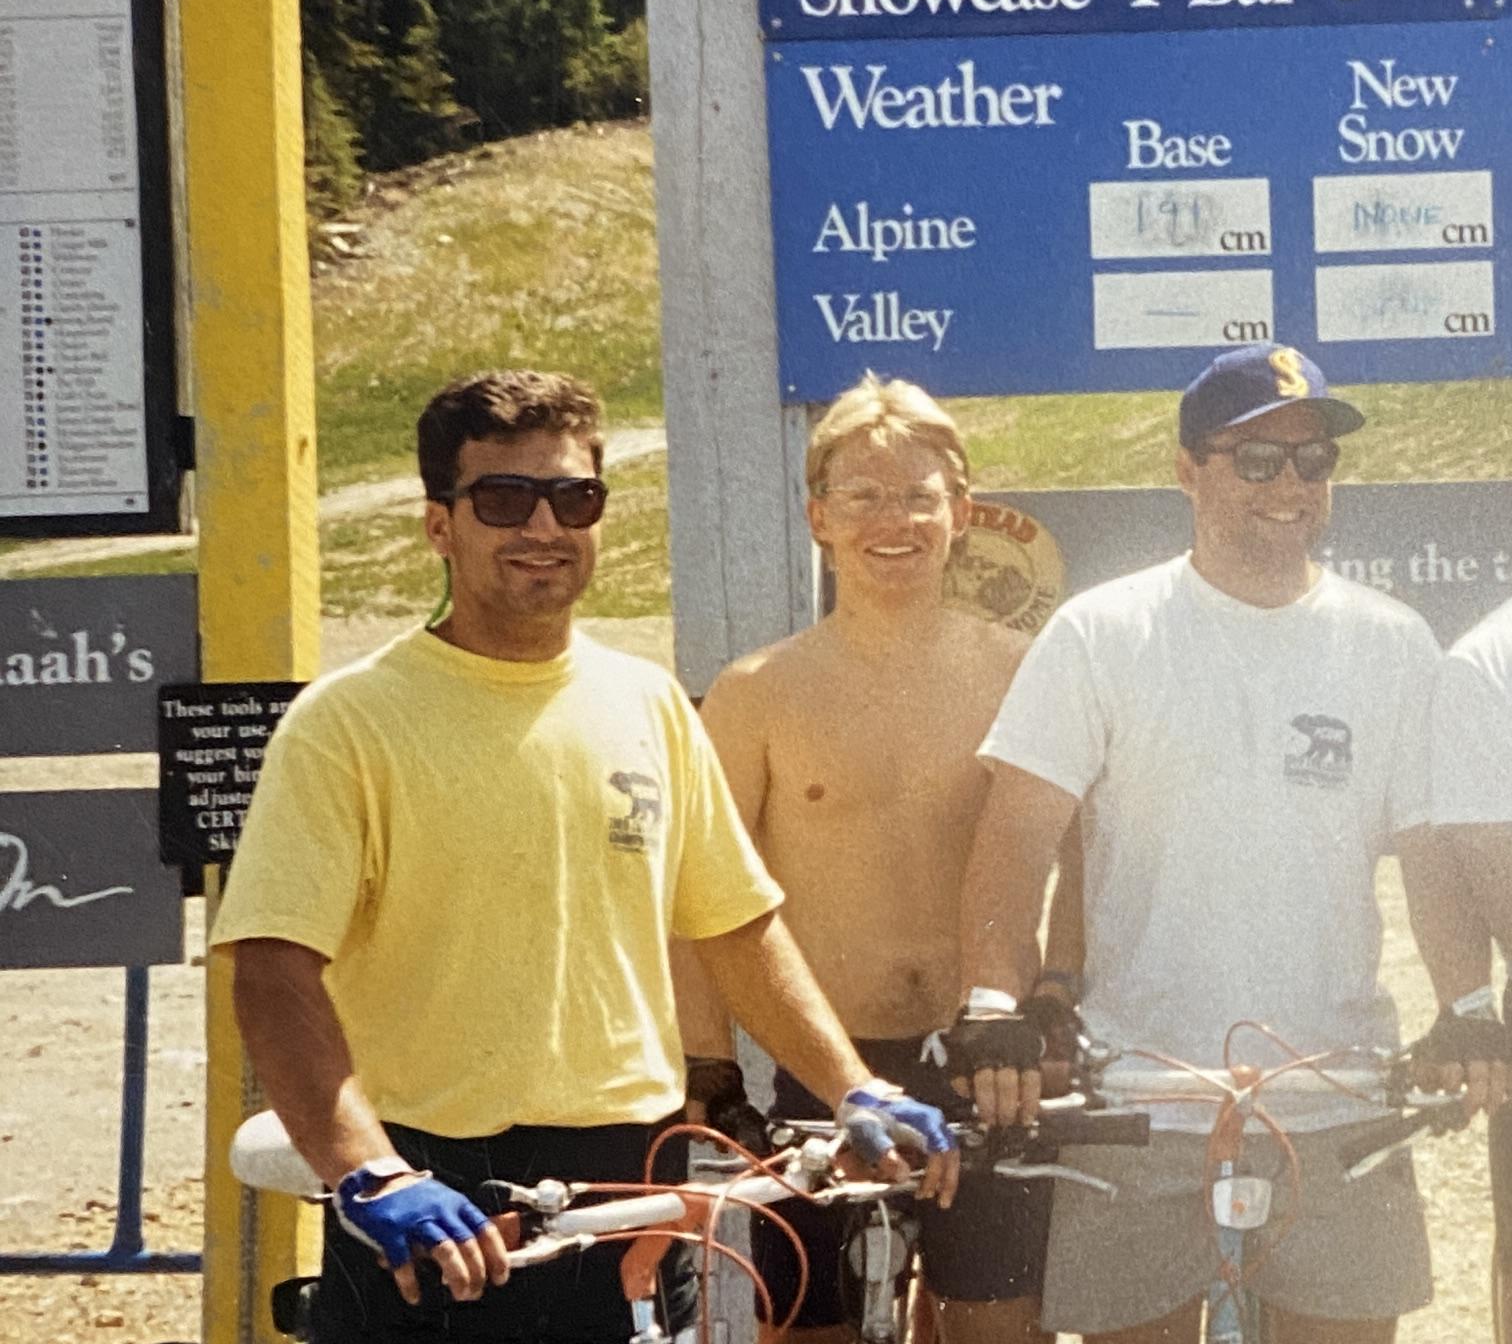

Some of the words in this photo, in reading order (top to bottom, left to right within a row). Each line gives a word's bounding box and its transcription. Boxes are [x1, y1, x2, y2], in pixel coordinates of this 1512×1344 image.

[802, 61, 1063, 129] Weather
[1348, 60, 1458, 111] New
[1124, 122, 1231, 168] Base
[1340, 117, 1464, 163] Snow
[813, 203, 976, 261] Alpine
[1221, 229, 1267, 251] cm
[1442, 223, 1488, 244] cm
[815, 294, 953, 351] Valley
[1223, 320, 1268, 341] cm
[1444, 313, 1490, 333] cm
[1268, 347, 1310, 397] S
[1408, 543, 1480, 583] the
[0, 631, 155, 685] aah's
[163, 700, 214, 718] These
[221, 697, 262, 715] tools
[269, 701, 289, 714] ar
[192, 726, 232, 740] your
[176, 748, 237, 766] suggest
[187, 771, 227, 787] your
